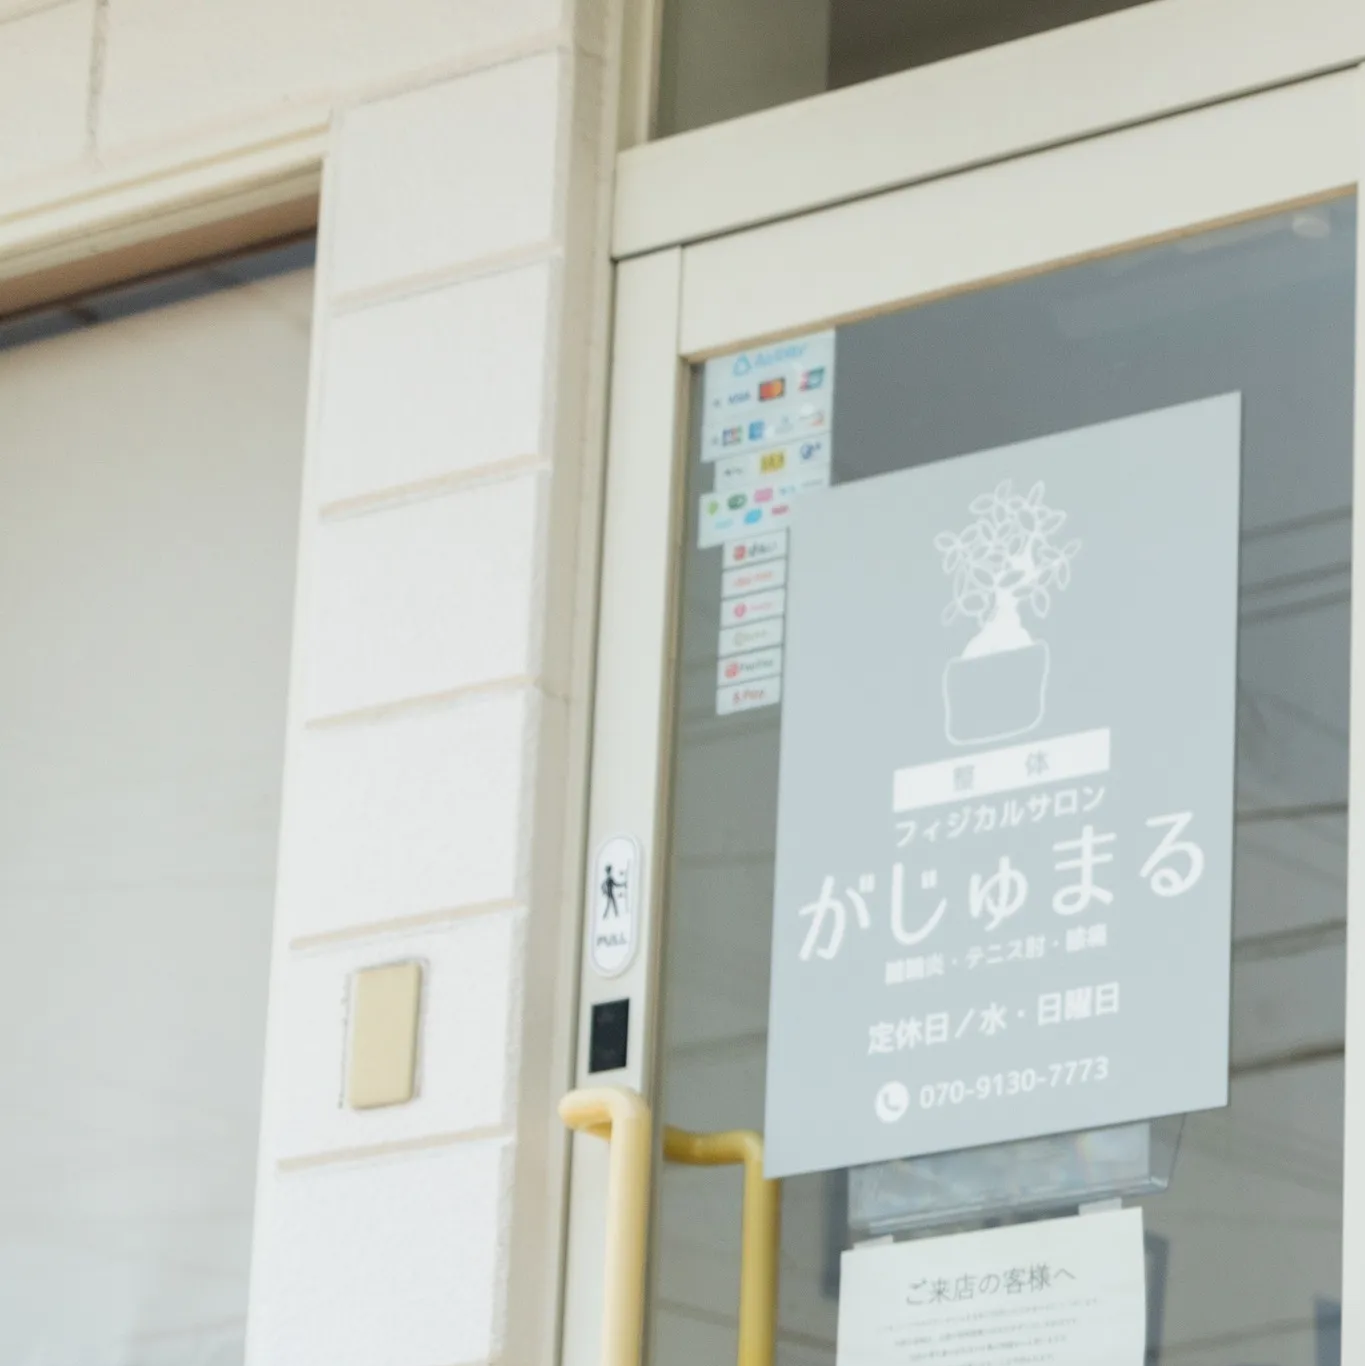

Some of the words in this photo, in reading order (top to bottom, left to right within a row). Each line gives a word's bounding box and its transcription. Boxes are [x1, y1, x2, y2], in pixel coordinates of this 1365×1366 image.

[895, 786, 1105, 847] フィジカルサロン
[798, 811, 1205, 960] がじゅまる
[919, 1055, 1110, 1110] 070-9130-7773
